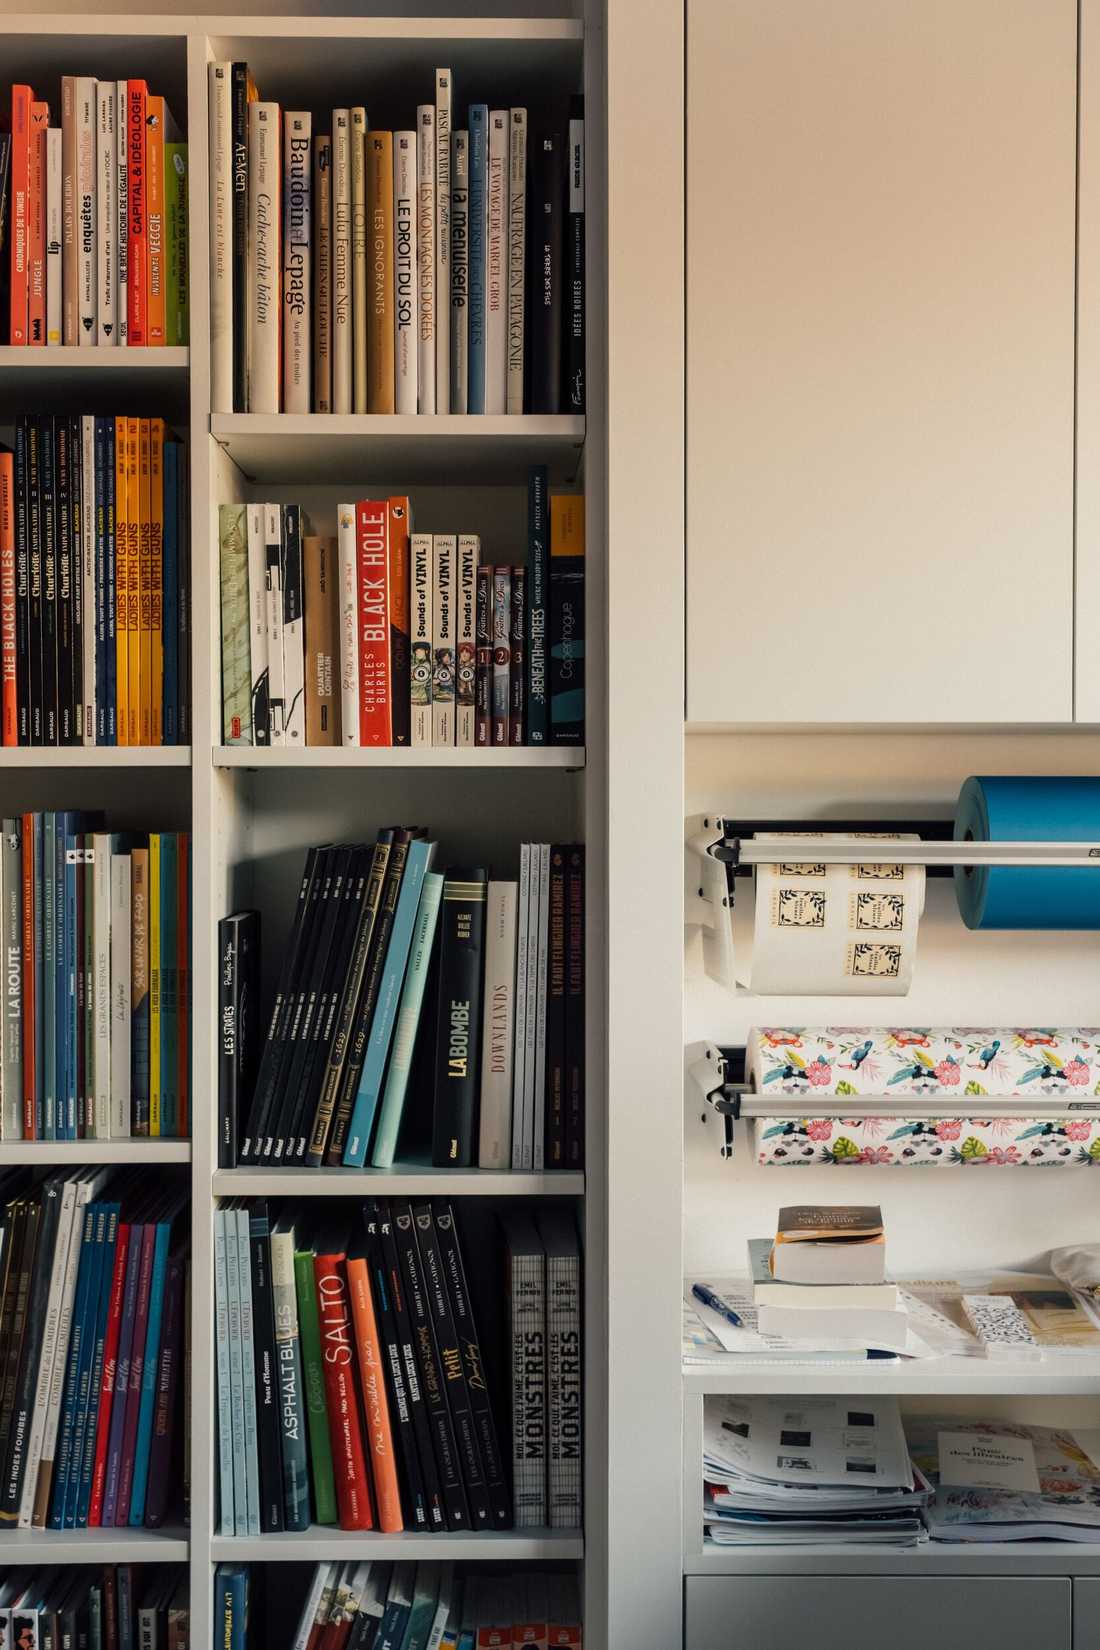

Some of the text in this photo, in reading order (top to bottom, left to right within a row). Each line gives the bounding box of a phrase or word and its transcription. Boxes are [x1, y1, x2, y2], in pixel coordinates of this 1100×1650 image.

[118, 164, 127, 198] L'ÉGALITÉ
[130, 92, 142, 234] CAPITAL & IDÉOLOGIE
[235, 142, 247, 192] Ar-Men
[290, 136, 309, 227] Baudoin
[438, 109, 450, 187] PASCAL RABATÉ
[16, 192, 25, 272] CHRONIQUES DE TUNISIE
[80, 194, 94, 253] enquêtes
[120, 199, 127, 209] DE
[490, 157, 501, 312] LE VOYAGE DE MARCEL GROB
[34, 260, 42, 297] JUNGLE
[48, 241, 62, 255] Lip
[118, 246, 127, 267] BRÈVE
[256, 193, 271, 324] Cache-cache bâton
[286, 241, 308, 315] Lepage
[336, 202, 349, 324] Lulu Femme Nue
[374, 209, 385, 314] LES IGNORANTS
[398, 199, 411, 330] LE DROIT DU SOL
[420, 182, 435, 341] LES MONTAGNES DORÉES
[452, 211, 468, 307] menuiserie
[509, 193, 523, 371] NAUFRAGE EN PATAGONIE
[318, 227, 328, 358] LE CHIEN QUI LOUCHE
[572, 280, 582, 336] IDÉES NOIRES
[1, 550, 16, 681] THE BLACK HOLES
[116, 522, 126, 632] LADIES WITH GUNS
[128, 522, 138, 632] LADIES WITH GUNS
[140, 522, 150, 632] LADIES WITH GUNS
[151, 522, 161, 632] LADIES WITH GUNS
[362, 512, 385, 640] BLACK HOLE
[416, 548, 426, 637] Sounds of VINYL
[439, 550, 450, 638] Sounds of VINYL
[462, 549, 473, 638] Sounds of VINYL
[532, 609, 544, 639] TREES
[560, 602, 575, 678] Copenhague
[364, 653, 375, 712] CHARLES
[378, 662, 386, 703] BURNS
[532, 649, 544, 692] BENEATH
[8, 947, 20, 995] ROUTE
[8, 998, 20, 1018] LA
[99, 953, 108, 1039] LES GRANDS ESPACES
[224, 1006, 234, 1055] LES STRATES
[449, 1000, 470, 1057] BOMBE
[491, 984, 508, 1073] DOWNLANDS
[42, 1308, 57, 1354] LUMIÈRES
[318, 1274, 352, 1366] SALTO
[515, 1334, 524, 1350] LES
[551, 1334, 560, 1350] LES
[262, 1351, 272, 1404] Peau d'Homme
[278, 1304, 300, 1440] ASPHALT BLUES
[403, 1344, 420, 1401] WANTED LUCKY LUKE
[442, 1347, 462, 1381] Petit
[525, 1331, 544, 1459] MONSTRES
[561, 1331, 579, 1459] MONSTRES
[8, 1410, 27, 1499] LES INDES FOURBES
[515, 1408, 524, 1426] QUE
[551, 1408, 560, 1426] QUE
